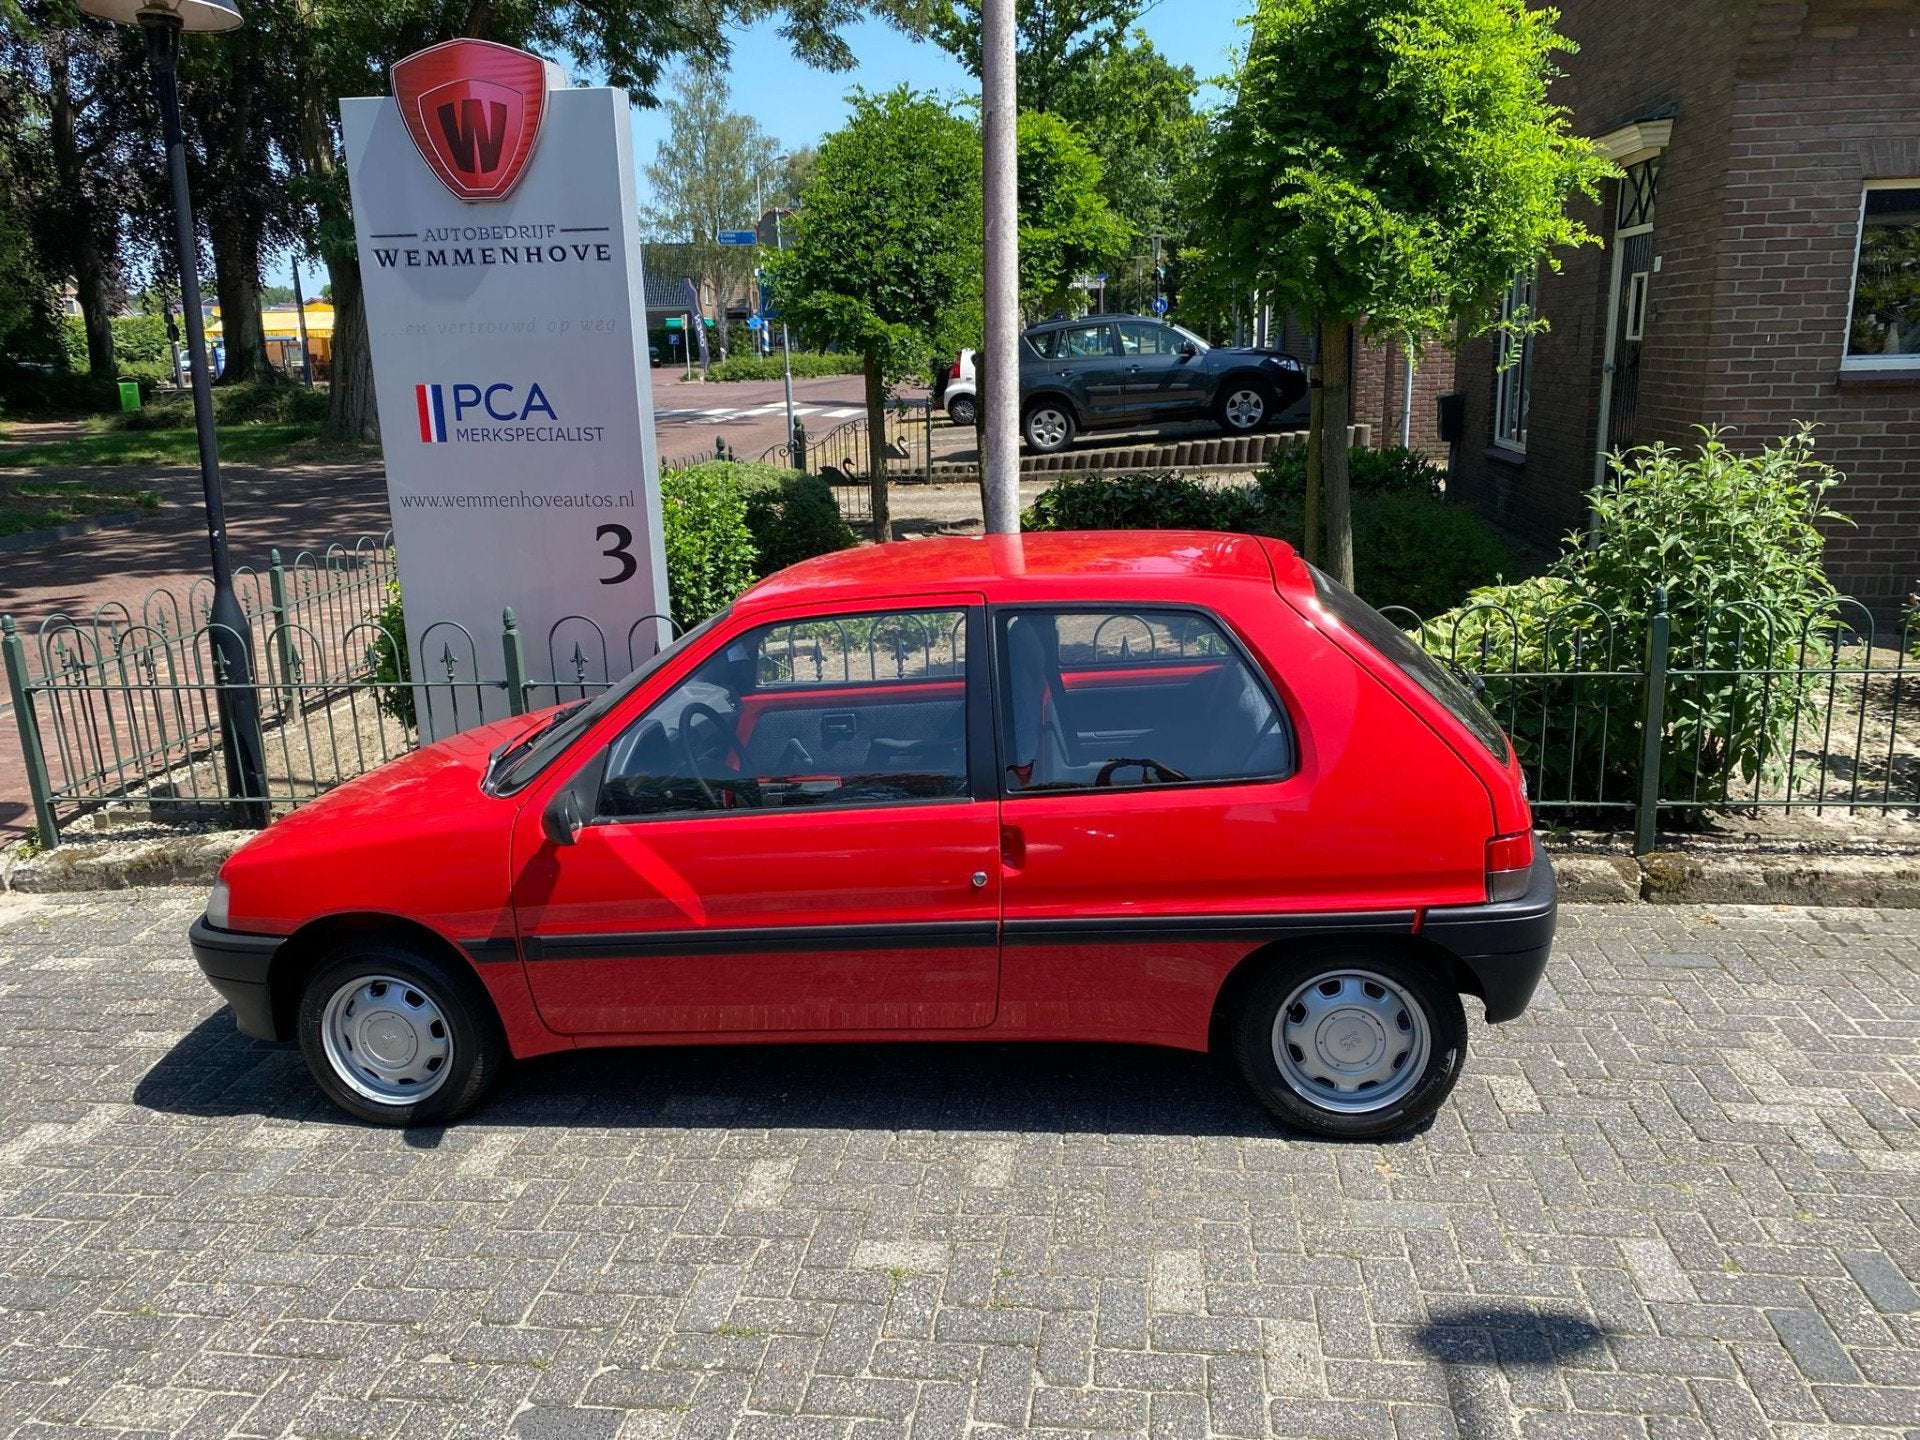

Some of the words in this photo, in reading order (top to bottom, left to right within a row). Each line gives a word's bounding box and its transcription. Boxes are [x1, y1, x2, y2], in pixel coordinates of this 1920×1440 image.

[437, 98, 508, 174] W
[422, 224, 557, 243] AUTOBEDRIJF
[371, 243, 611, 268] WEMMENHOVE
[437, 316, 536, 336] vertrouwd
[547, 318, 570, 335] op
[581, 317, 616, 335] weg
[452, 382, 559, 422] PCA
[456, 427, 605, 443] MERKSPECIALIST
[400, 490, 635, 509] www.wemmenhoveautos.nl
[596, 523, 637, 585] 3
